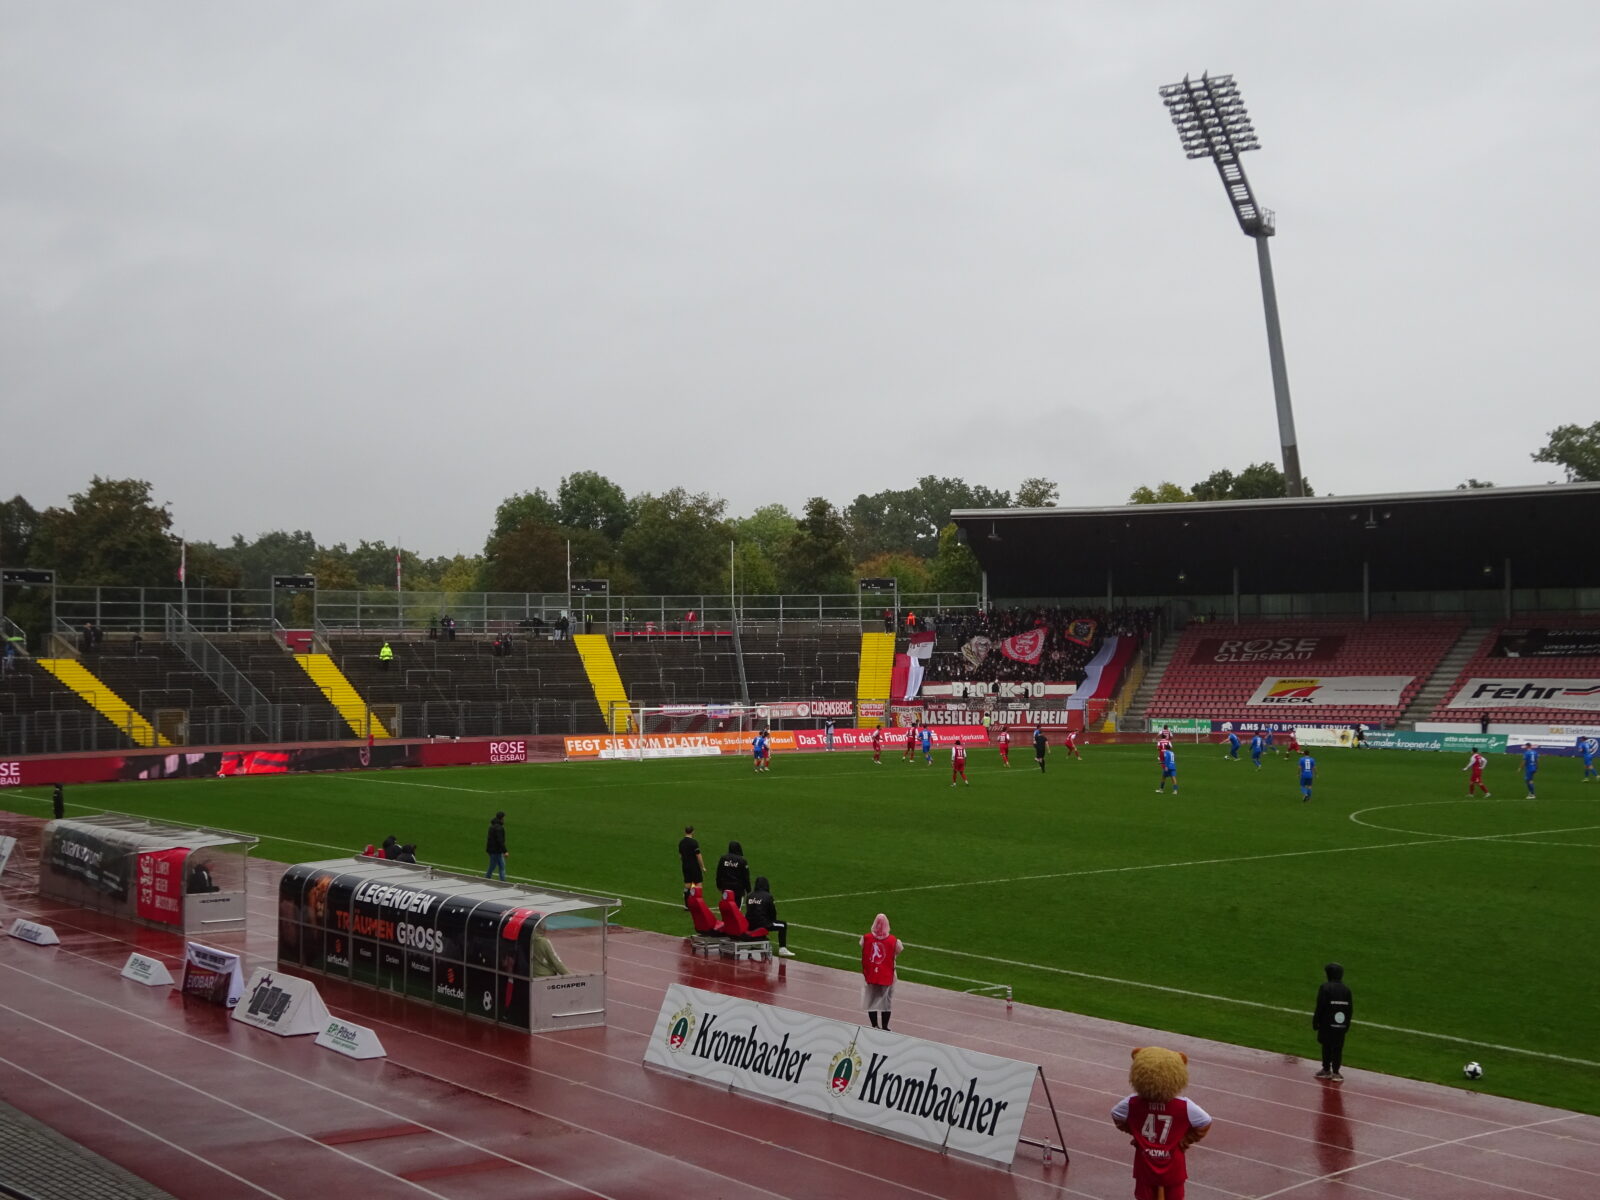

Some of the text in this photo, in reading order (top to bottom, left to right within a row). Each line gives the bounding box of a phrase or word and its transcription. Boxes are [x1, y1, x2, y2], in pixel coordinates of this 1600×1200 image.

[1218, 639, 1320, 653] ROSE
[1214, 652, 1312, 662] GLEISBAU
[1471, 684, 1562, 700] Fehr
[922, 710, 1068, 727] KASSELER PORT VEREIN
[1240, 723, 1260, 731] AHS
[566, 735, 709, 752] FEGT SIE VOM PLATZ!
[771, 736, 793, 744] Kassel
[798, 735, 817, 745] Das
[817, 735, 842, 745] Tem
[843, 733, 856, 744] für
[490, 741, 525, 754] ROSE
[490, 753, 526, 762] GLEISBAU
[355, 882, 438, 915] LEGENDEN
[335, 907, 444, 954] TRÄUMEN GROSS
[436, 984, 465, 1000] airfect.de
[692, 1012, 812, 1084] Krombacher
[858, 1052, 1008, 1136] Krombacher
[1141, 1113, 1173, 1145] 47
